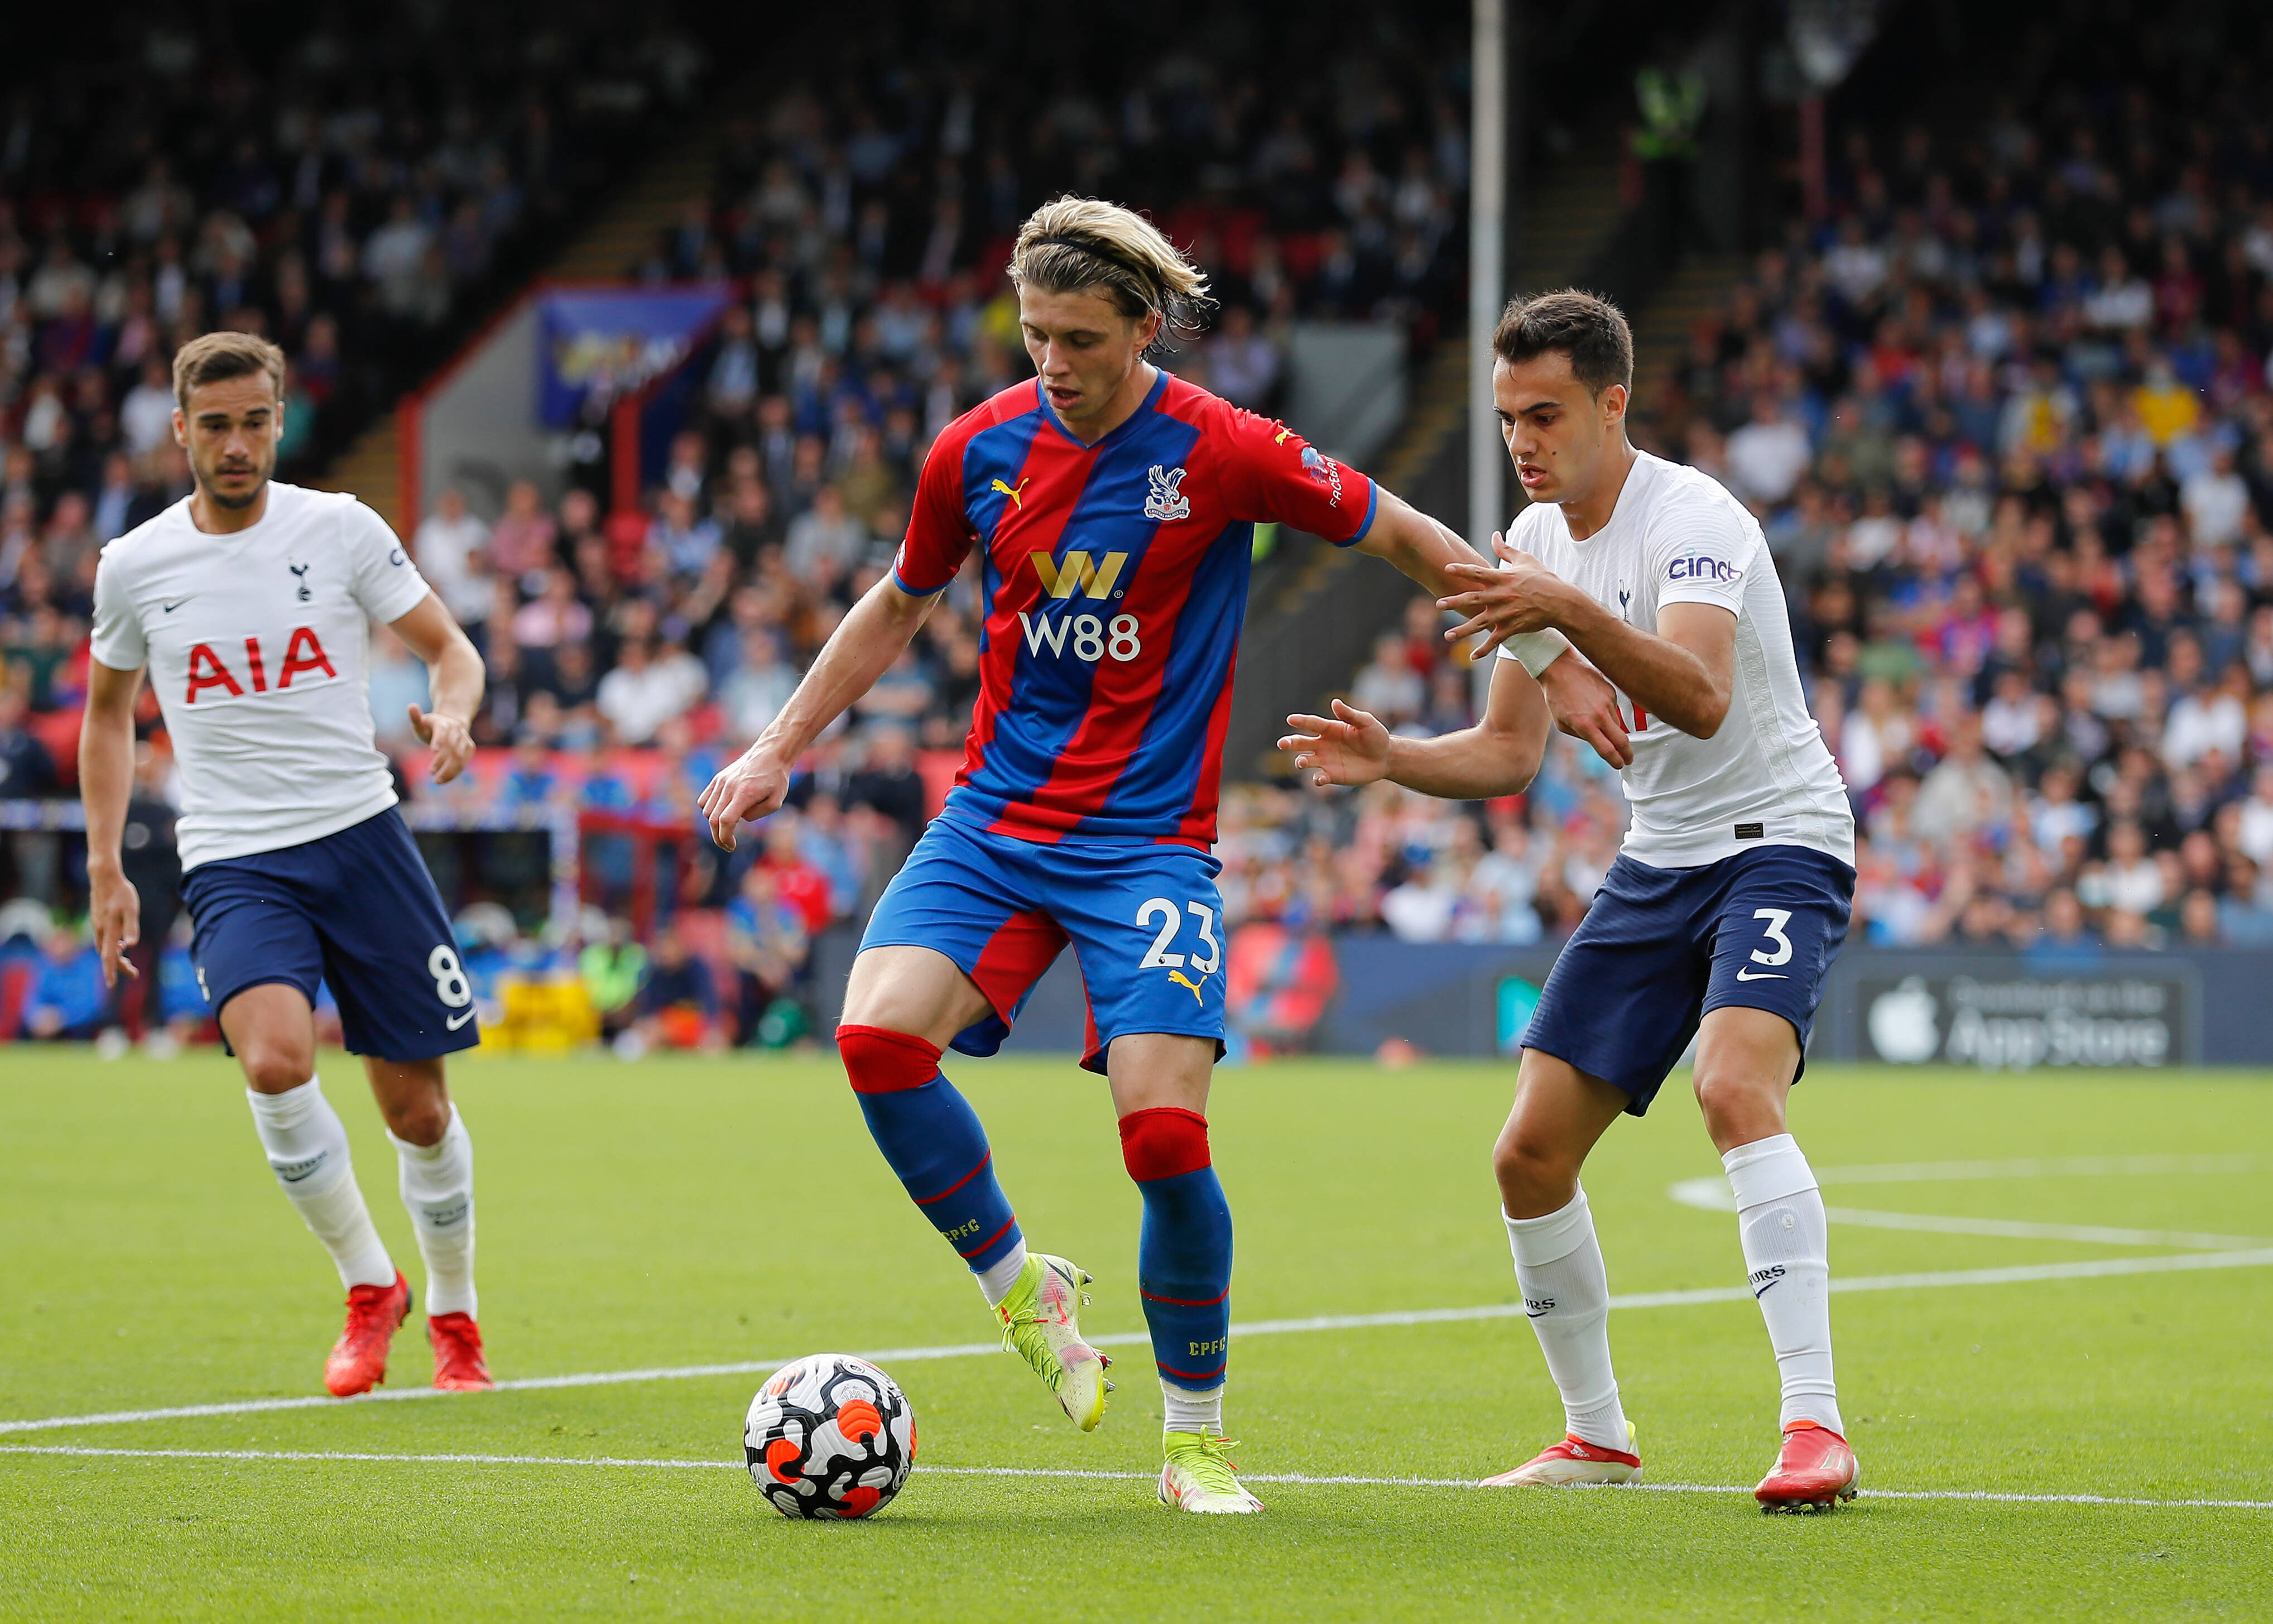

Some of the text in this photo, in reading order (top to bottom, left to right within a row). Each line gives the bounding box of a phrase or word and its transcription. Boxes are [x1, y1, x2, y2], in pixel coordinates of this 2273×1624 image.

[1148, 509, 1165, 518] CRYSTAL
[1029, 550, 1129, 600] W
[1017, 612, 1141, 662] W88
[186, 627, 337, 704] AIA
[1135, 897, 1220, 975] 23
[1750, 907, 1793, 966] 3
[427, 944, 472, 1008] 8
[941, 1218, 980, 1242] CPFC
[1189, 1336, 1226, 1356] CPFC
